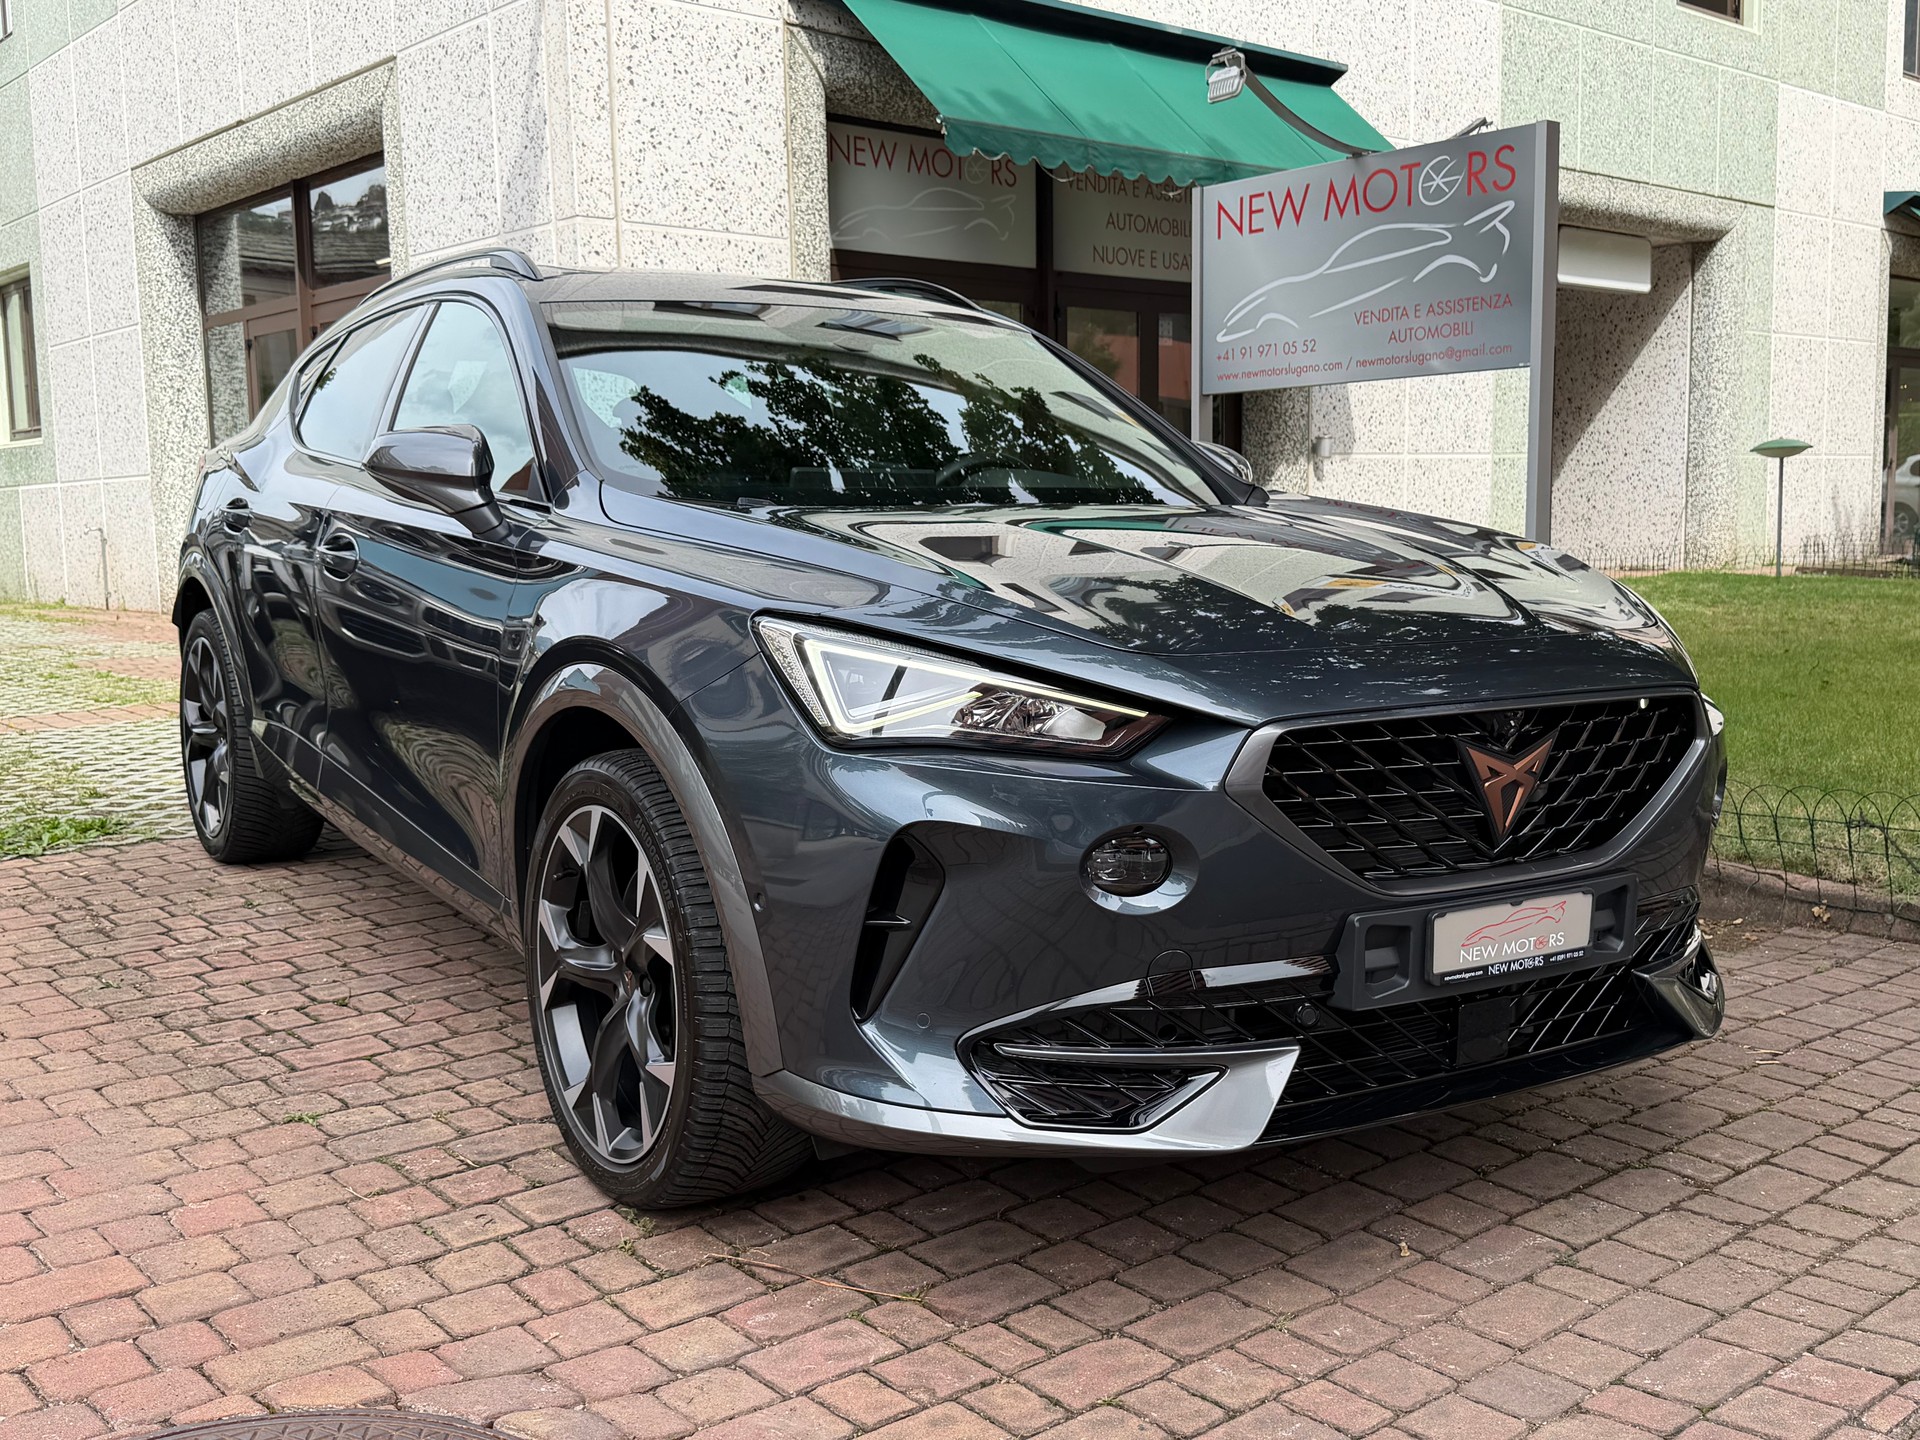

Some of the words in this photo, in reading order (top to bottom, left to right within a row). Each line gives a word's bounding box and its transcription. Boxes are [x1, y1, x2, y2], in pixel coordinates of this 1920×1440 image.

[829, 131, 897, 172] NEW
[1066, 170, 1127, 196] VENDITA
[1132, 179, 1140, 198] E
[1216, 183, 1310, 240] NEW
[1323, 143, 1517, 222] MOTORS
[1092, 245, 1145, 267] NUOVE
[1150, 250, 1157, 268] E
[1162, 252, 1192, 271] USA
[1354, 306, 1409, 325] VENDITA
[1414, 303, 1421, 319] E
[1426, 293, 1513, 318] ASSISTENZA
[1387, 321, 1474, 344] AUTOMOBILI
[1216, 348, 1235, 361] +41
[1240, 346, 1252, 360] 91
[1257, 343, 1278, 358] 971
[1283, 341, 1298, 355] 05
[1302, 338, 1317, 353] 52
[1216, 360, 1343, 382] www.newmotorslugano.com
[1355, 342, 1512, 367] newmotorslugano@gmail.com
[1459, 943, 1499, 964] NEW
[1502, 932, 1565, 956] MOTORS
[1488, 963, 1508, 975] NEW
[1510, 956, 1544, 972] MOTORS
